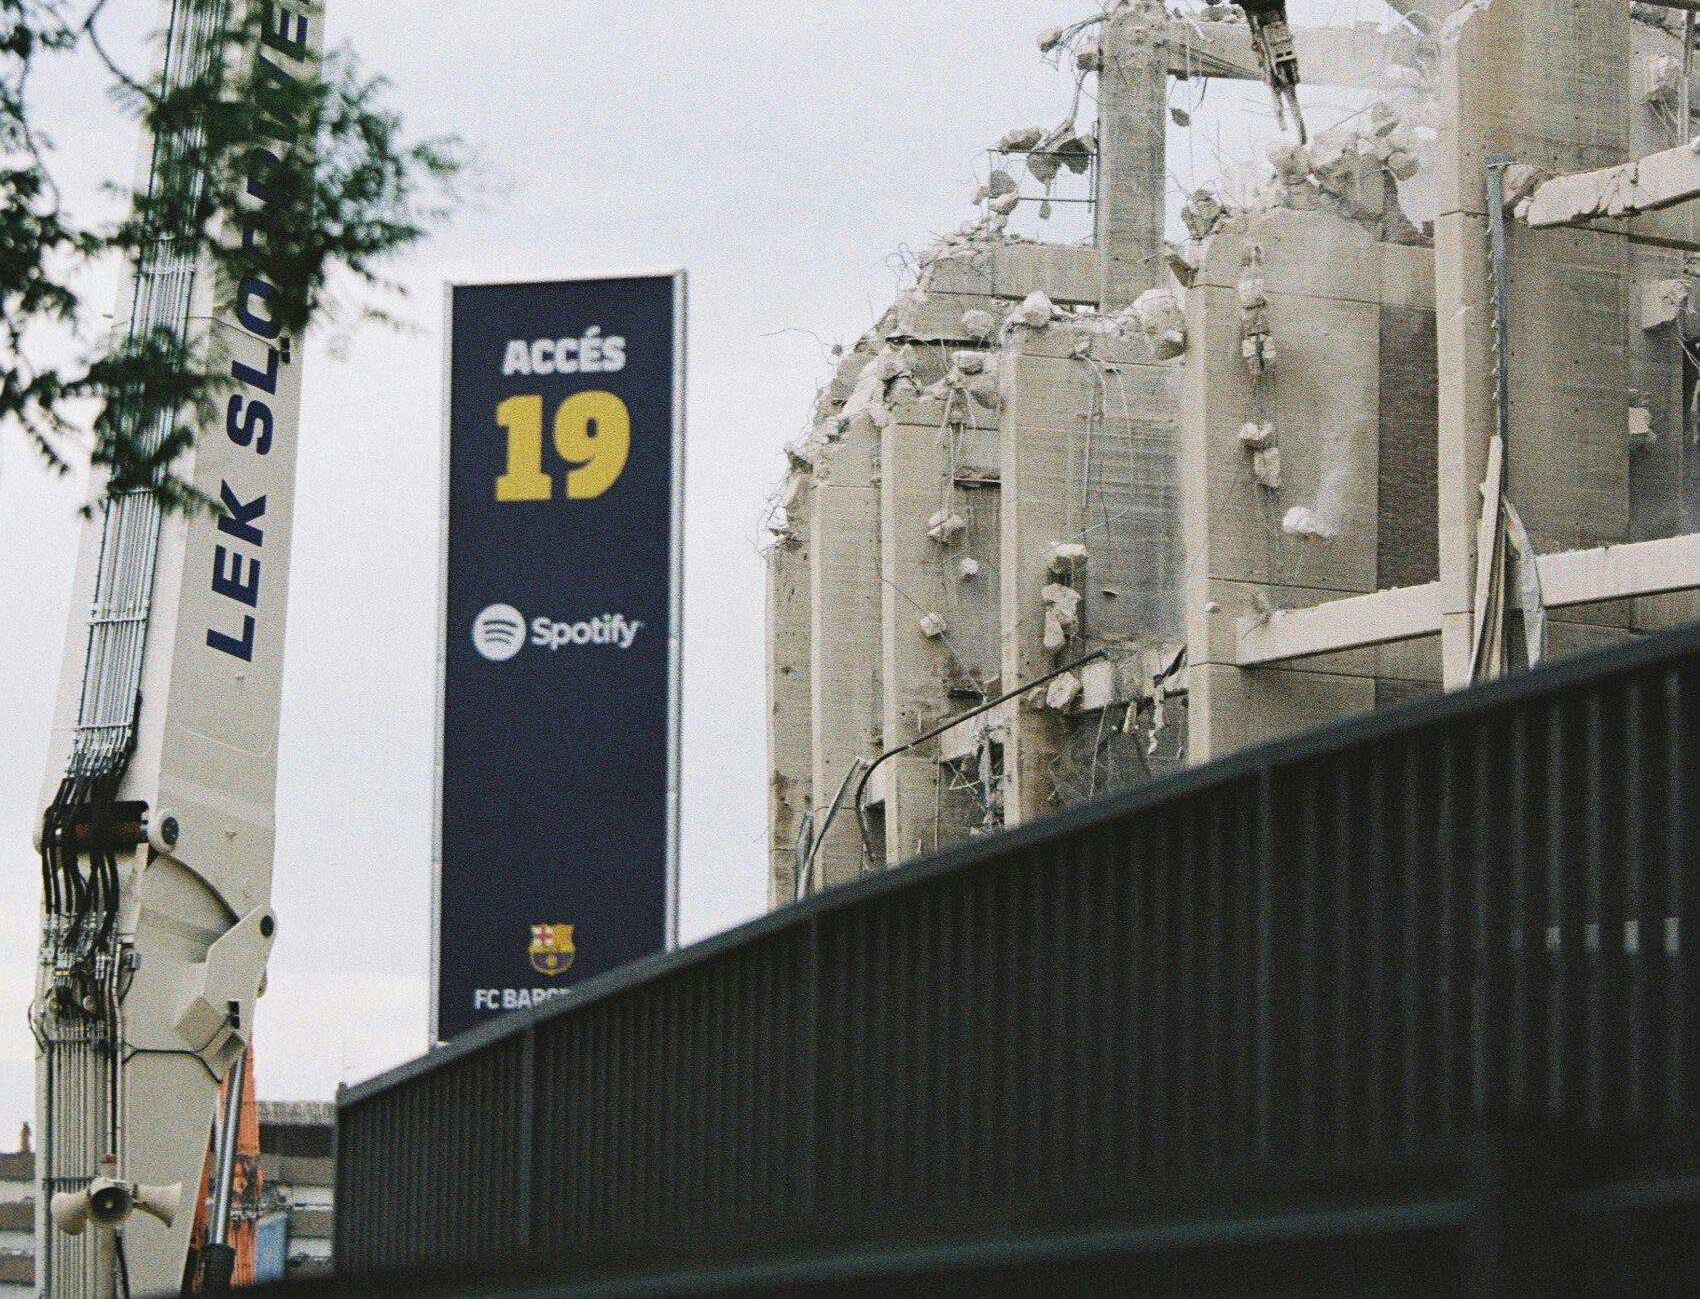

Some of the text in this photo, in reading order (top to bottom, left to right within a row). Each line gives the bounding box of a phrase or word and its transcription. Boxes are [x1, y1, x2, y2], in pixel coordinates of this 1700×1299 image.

[502, 327, 627, 376] ACCÉS
[494, 388, 631, 502] 19
[205, 479, 266, 662] LEK
[530, 611, 641, 651] Spotify
[474, 988, 500, 1010] FC
